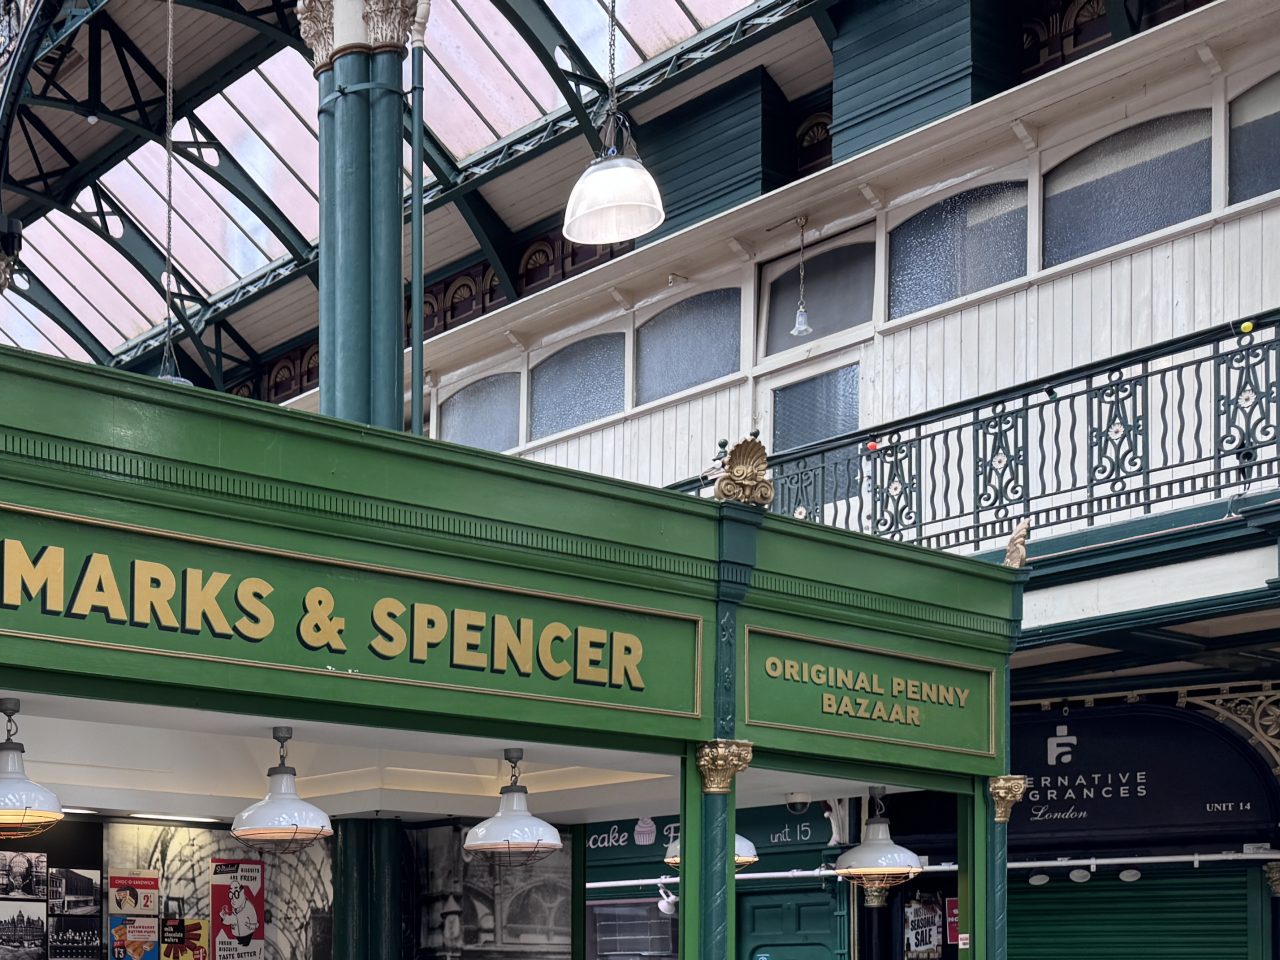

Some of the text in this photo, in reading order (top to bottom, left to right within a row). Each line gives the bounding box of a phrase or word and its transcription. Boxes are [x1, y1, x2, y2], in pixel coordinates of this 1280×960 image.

[296, 587, 346, 653] &
[368, 597, 646, 691] SPENCER
[765, 656, 970, 707] ORIGINAL PENNY
[821, 692, 921, 727] BAZAAR
[1030, 804, 1088, 821] London
[1206, 802, 1251, 812] UNIT 14
[586, 825, 628, 848] cake
[770, 822, 811, 843] unit 15
[911, 914, 936, 931] SEASONAL
[915, 928, 932, 948] SALE
